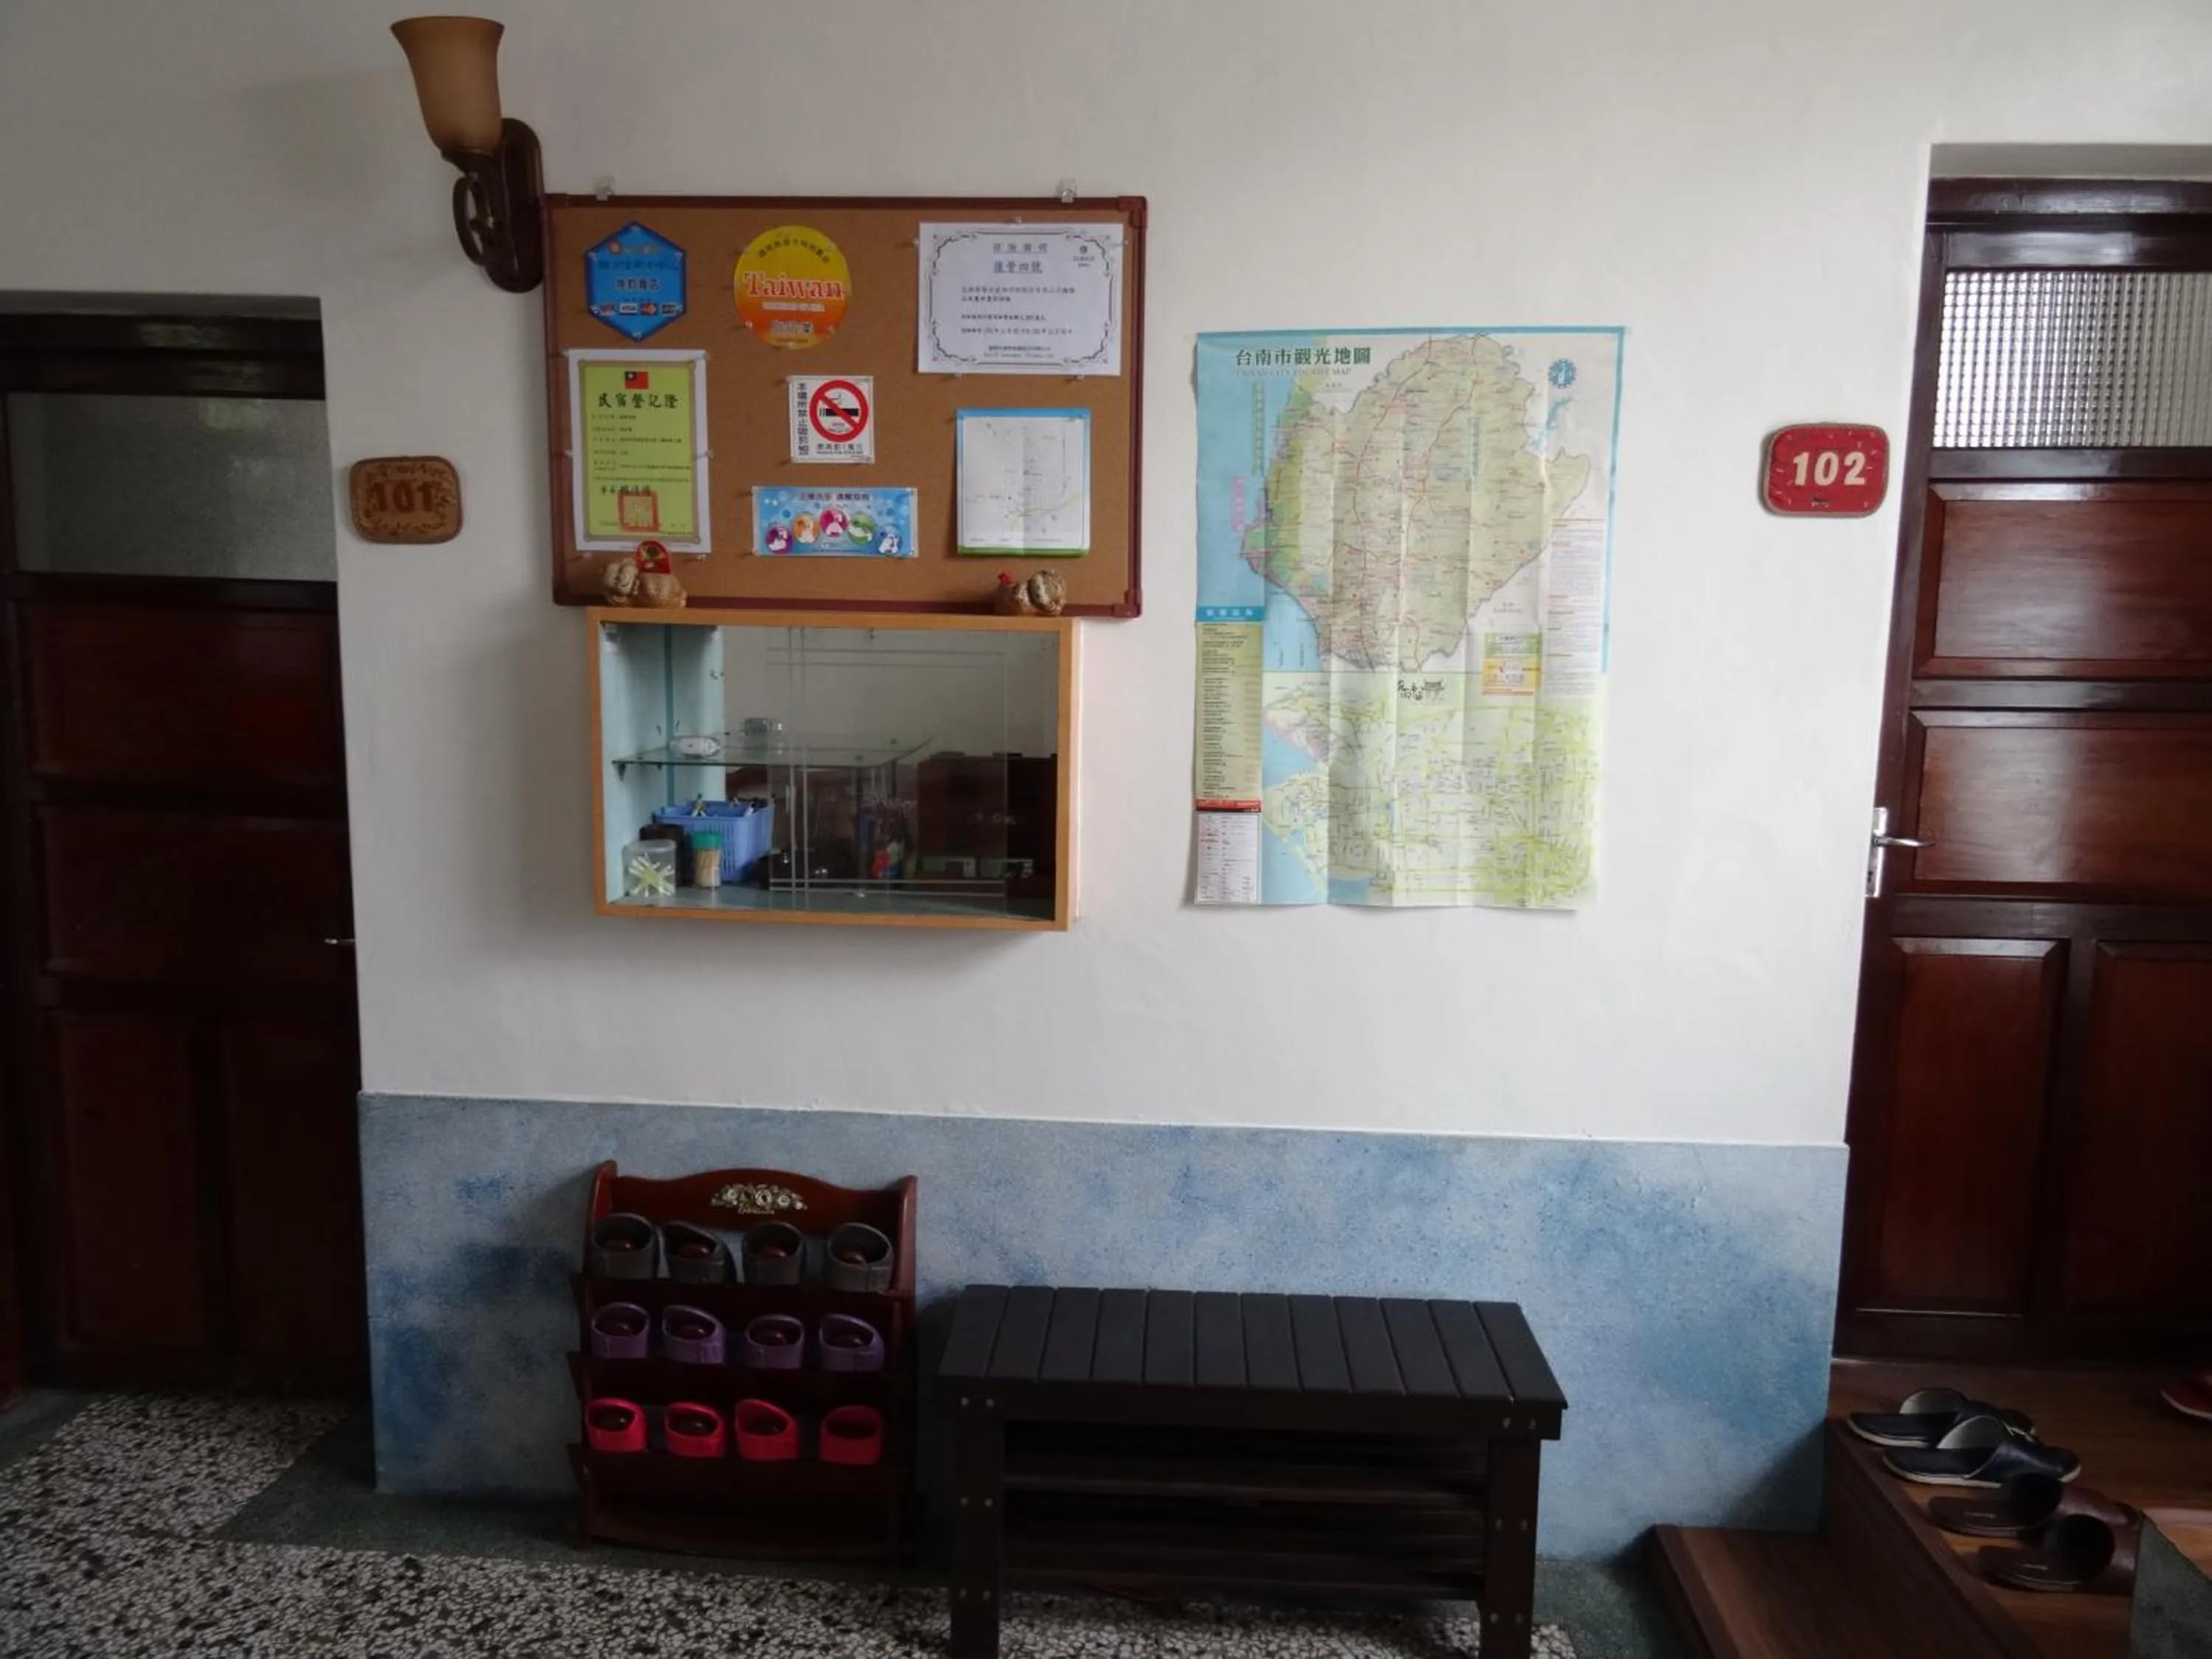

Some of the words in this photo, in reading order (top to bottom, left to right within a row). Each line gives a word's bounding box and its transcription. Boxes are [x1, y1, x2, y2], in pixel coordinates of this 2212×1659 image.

[744, 271, 844, 299] Taiwan
[1236, 347, 1371, 366] 台南市觀光地圖
[599, 392, 678, 408] 民宿登記證
[1793, 451, 1865, 486] 102
[372, 481, 434, 512] 101
